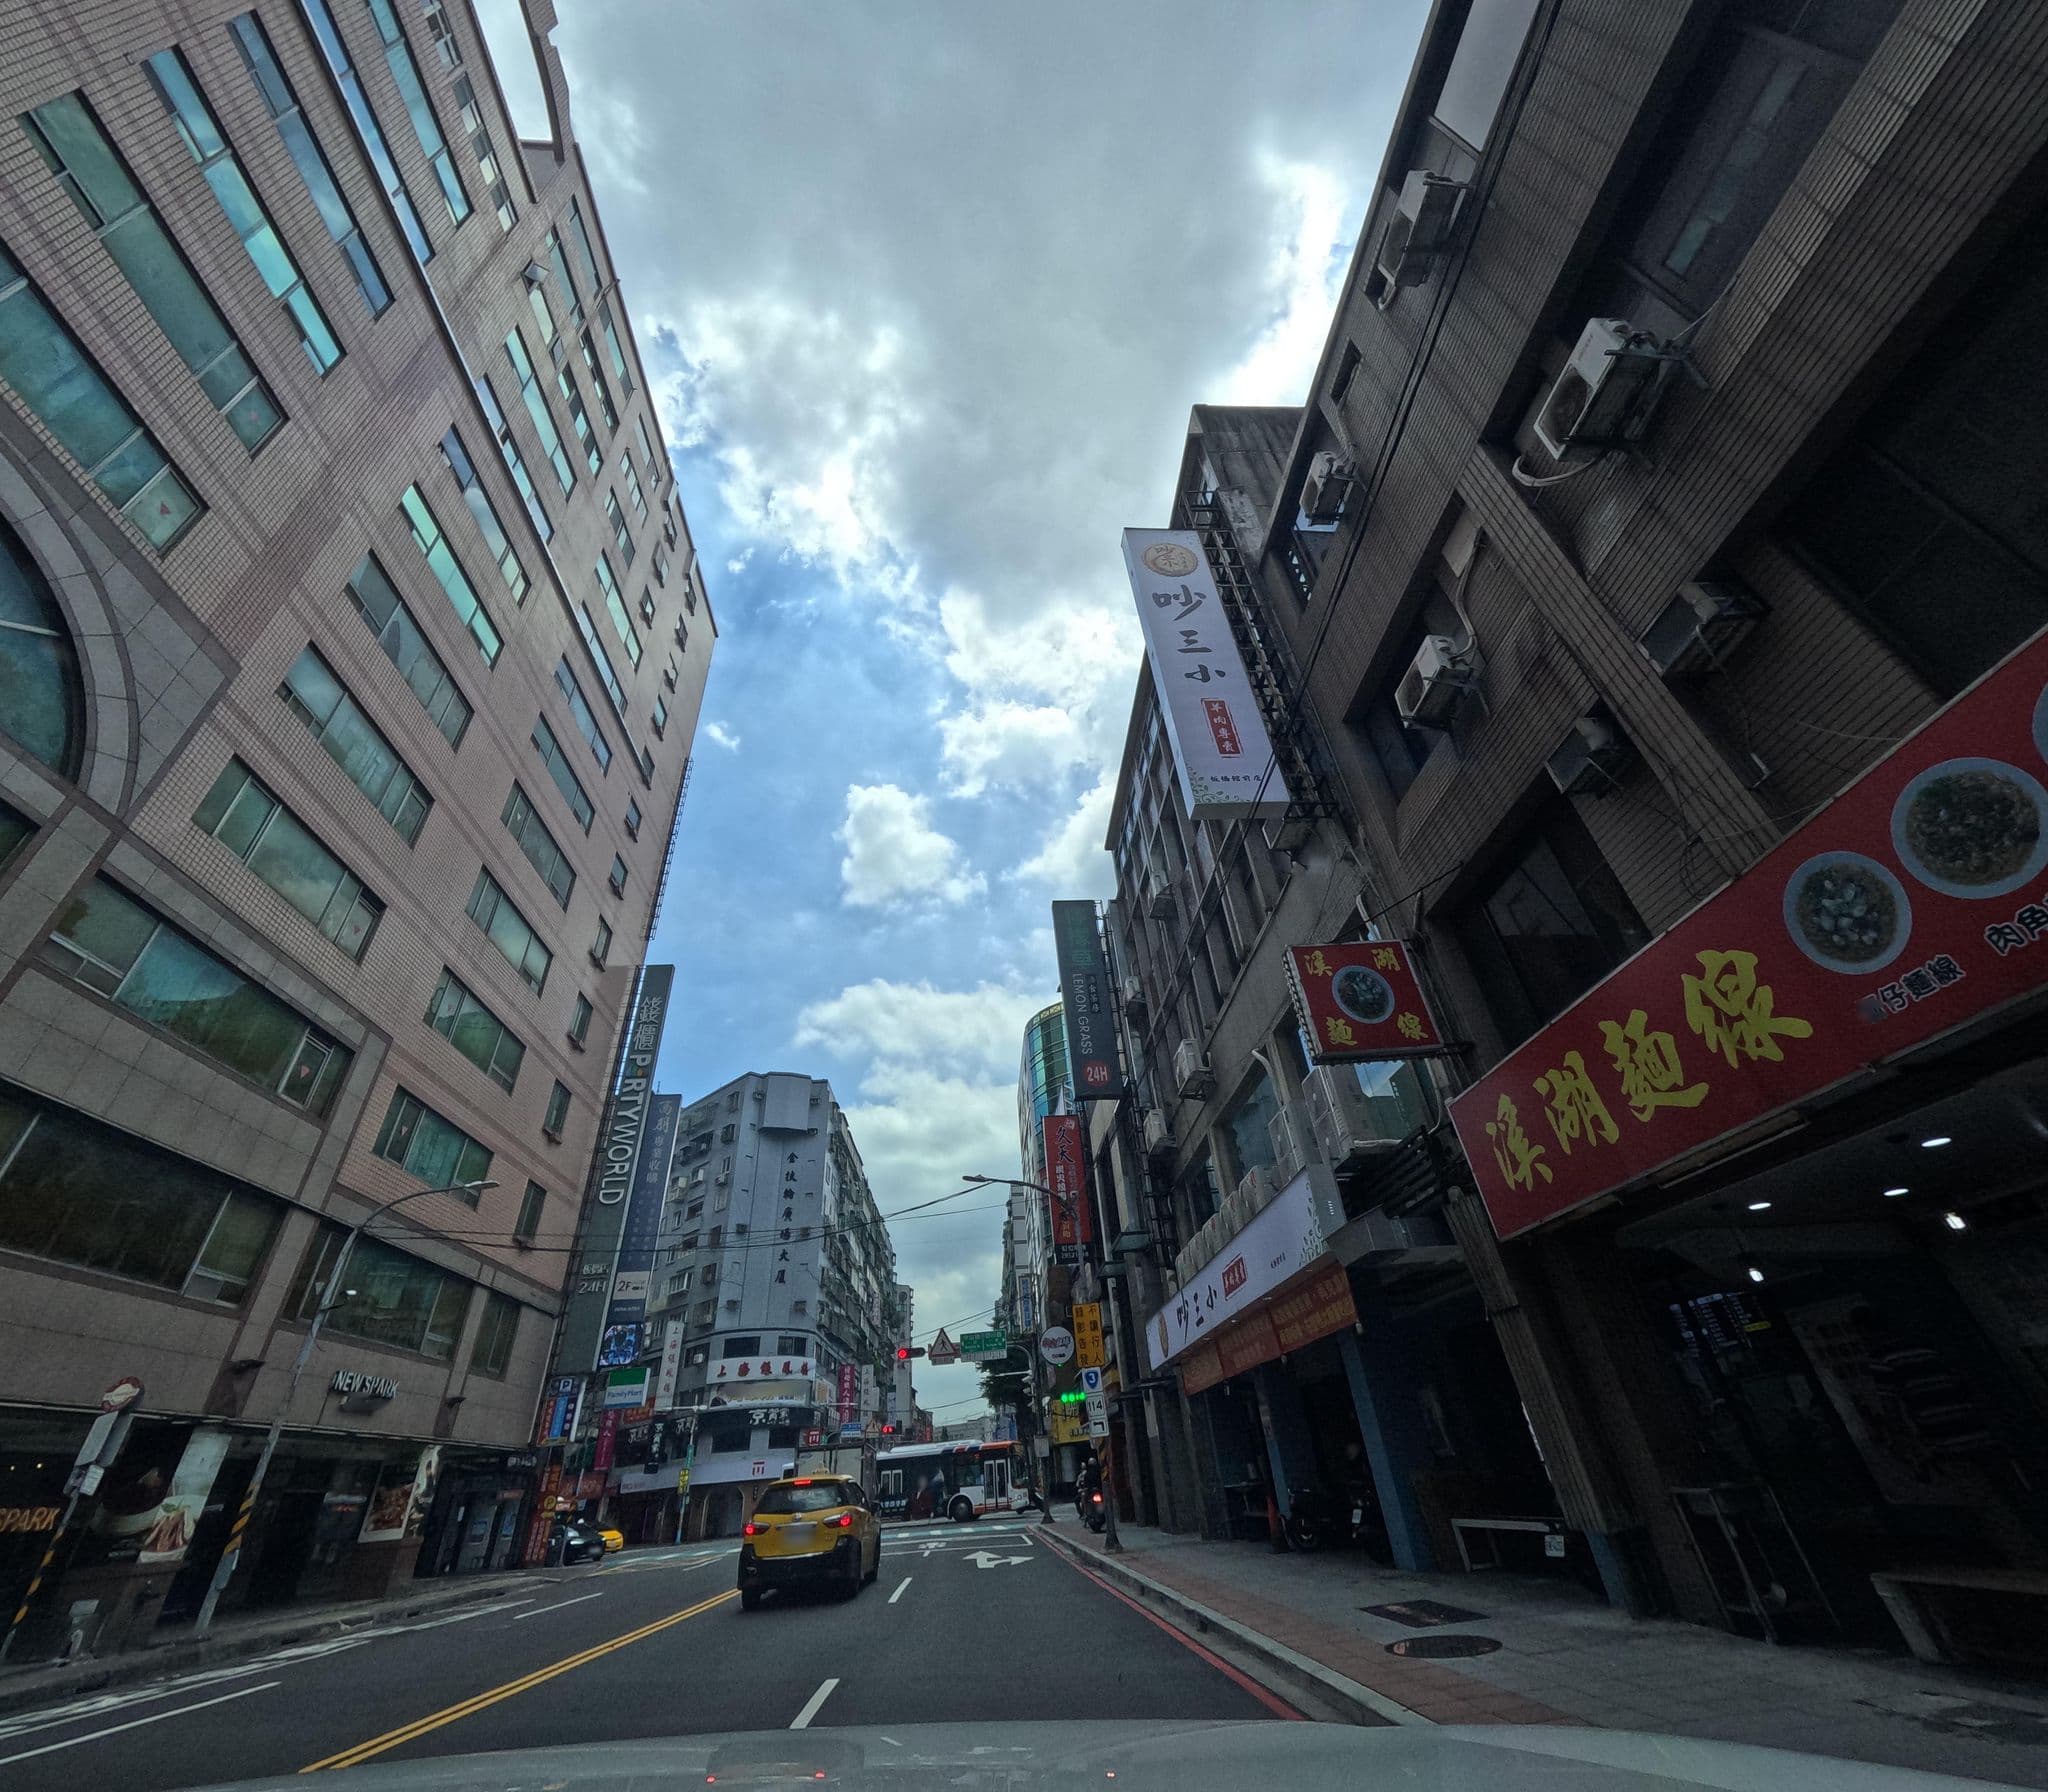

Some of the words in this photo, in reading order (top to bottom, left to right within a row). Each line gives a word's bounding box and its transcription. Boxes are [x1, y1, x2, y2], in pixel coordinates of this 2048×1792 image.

[1152, 584, 1226, 684] 吵三小
[1072, 973, 1087, 1013] LEMON
[1862, 954, 1965, 1021] 仔麵線
[1078, 1017, 1093, 1055] GRASS
[1087, 1066, 1108, 1082] 24H
[599, 1054, 652, 1205] PRTYWORLD
[578, 1280, 608, 1295] 24H
[335, 1371, 365, 1392] NEW
[1089, 1373, 1097, 1383] 3
[607, 1388, 643, 1399] FamilyMart
[1088, 1400, 1103, 1412] 114
